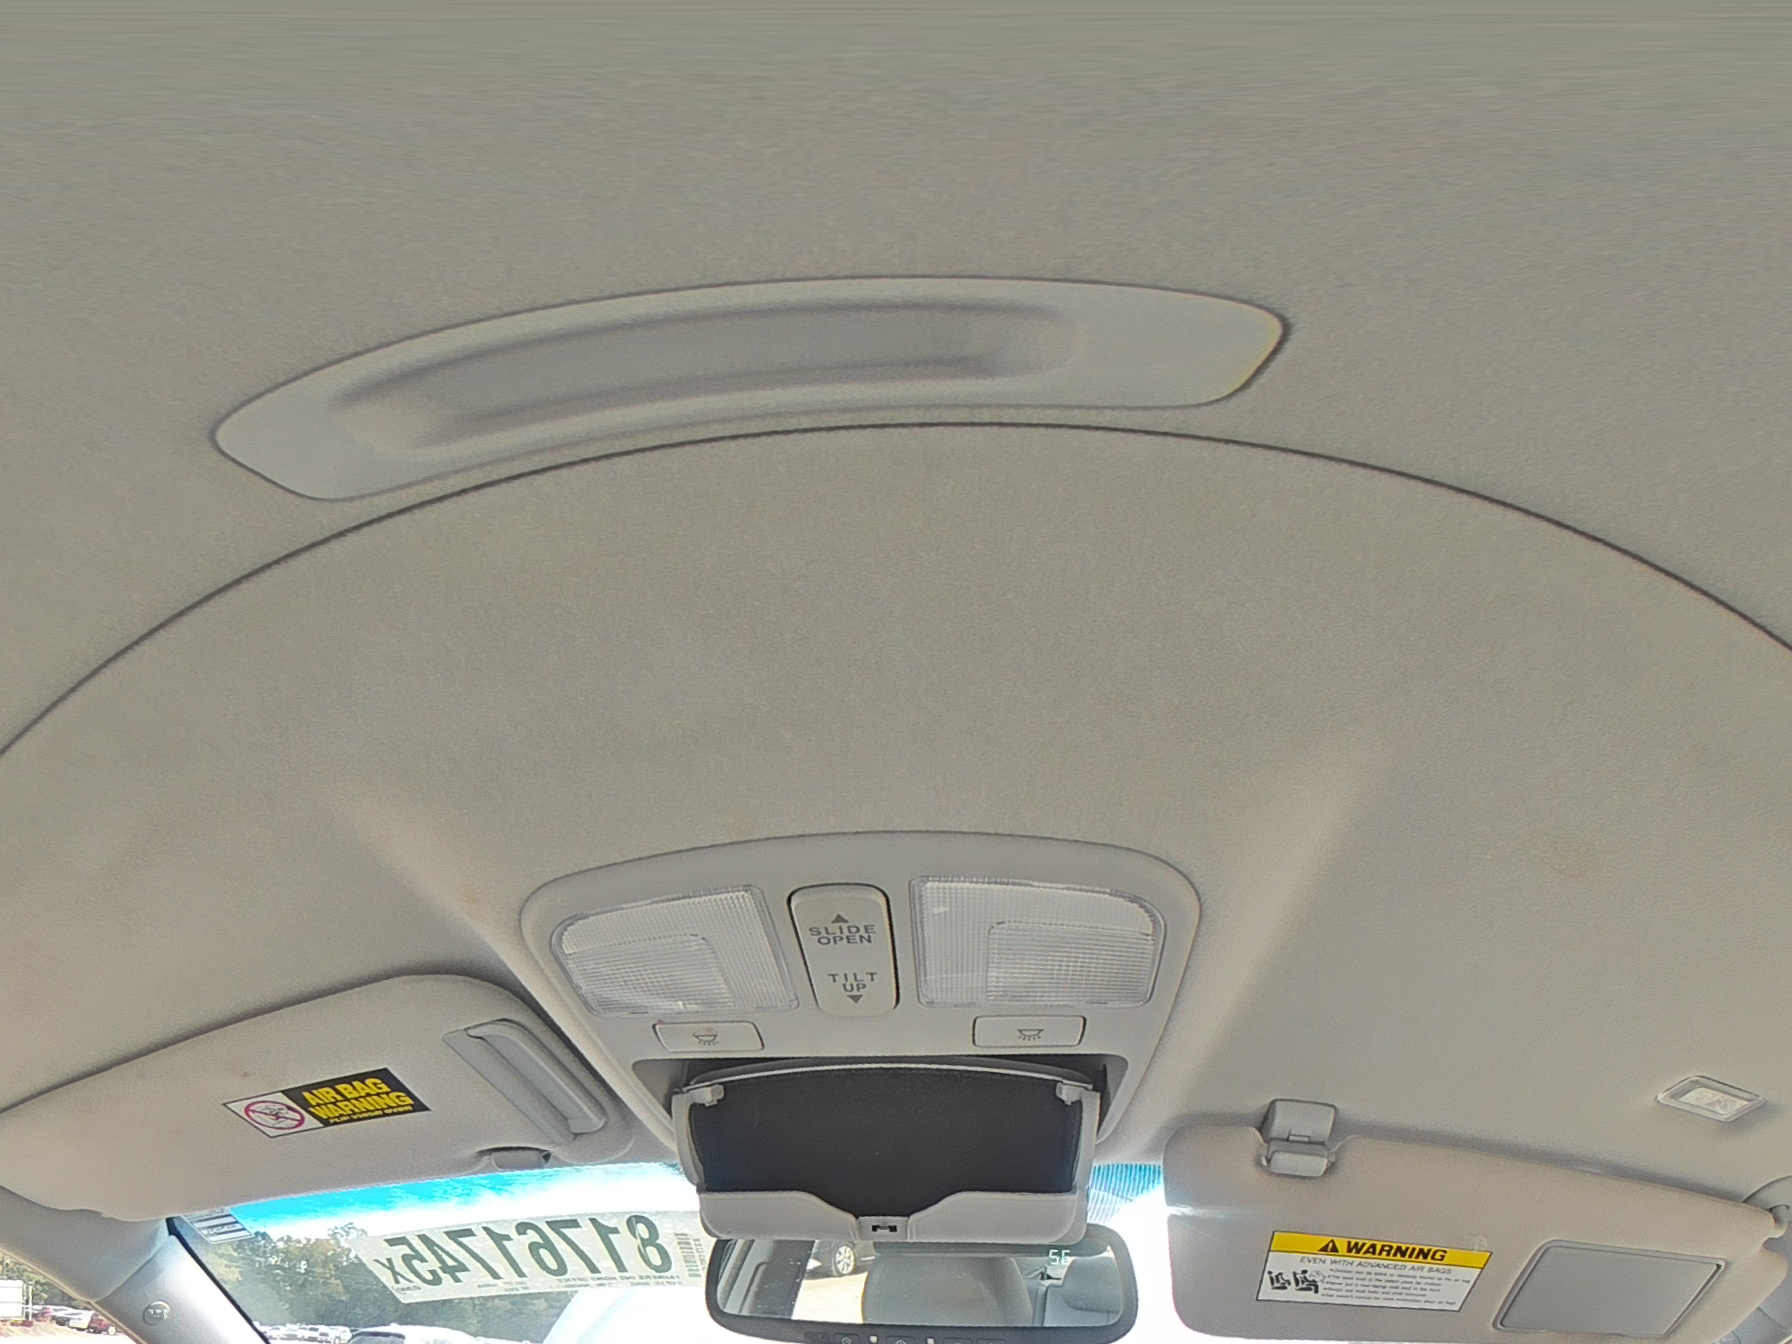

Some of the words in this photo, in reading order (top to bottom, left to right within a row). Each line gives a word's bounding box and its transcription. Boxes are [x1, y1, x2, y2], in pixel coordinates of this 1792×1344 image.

[808, 924, 877, 936] SLIDE
[817, 934, 872, 945] OPEN
[827, 971, 878, 982] TILT
[843, 983, 867, 993] UP
[302, 1087, 345, 1106] AIR
[335, 1078, 391, 1099] BAG
[308, 1092, 414, 1119] WARNING
[1345, 1240, 1448, 1262] WARNING
[1299, 1256, 1326, 1265] EVEN
[1330, 1258, 1354, 1267] WITH
[1356, 1260, 1407, 1271] ADVANCED
[1427, 1266, 1453, 1275] BAGS
